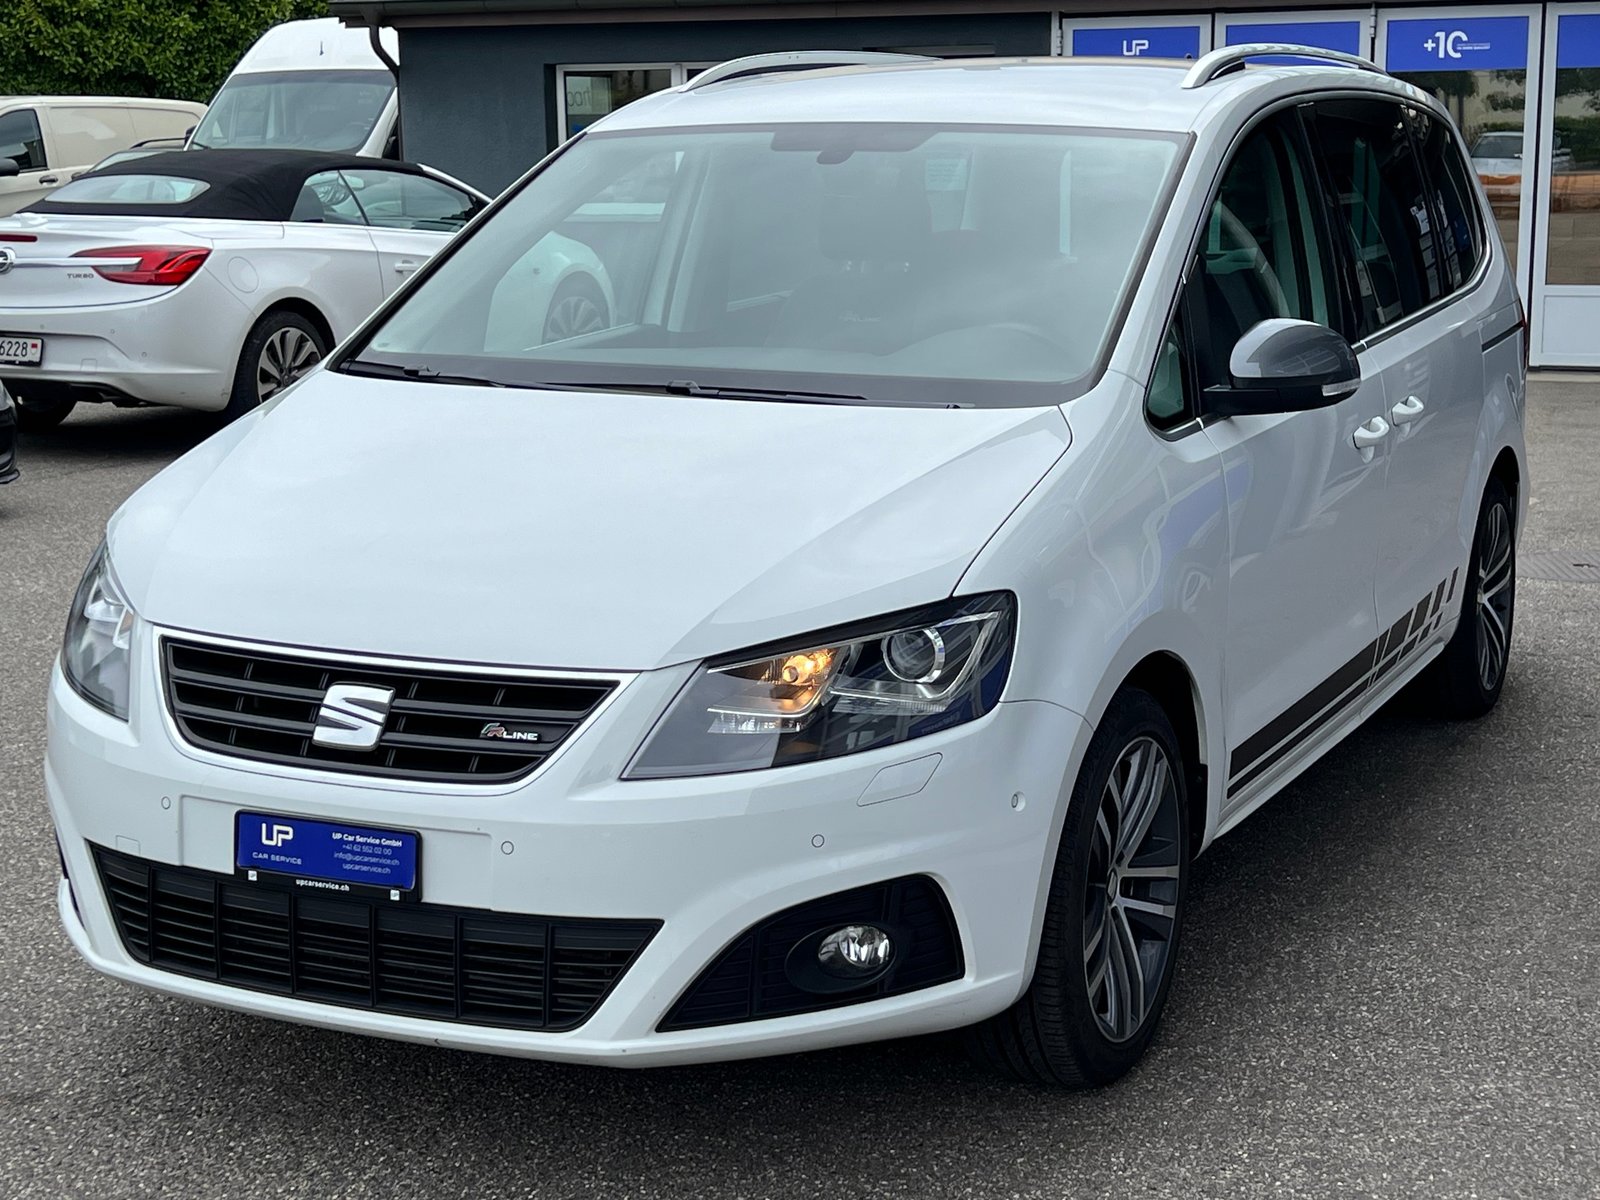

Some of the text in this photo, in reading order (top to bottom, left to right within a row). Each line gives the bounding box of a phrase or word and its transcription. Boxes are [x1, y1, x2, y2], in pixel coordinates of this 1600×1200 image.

[1123, 40, 1149, 56] UP
[261, 822, 294, 847] UP
[332, 832, 402, 847] UP Car Service GmbH
[271, 854, 302, 865] SERVICE
[342, 863, 391, 874] upcarservice.ch
[295, 879, 350, 892] upcarservice.ch
